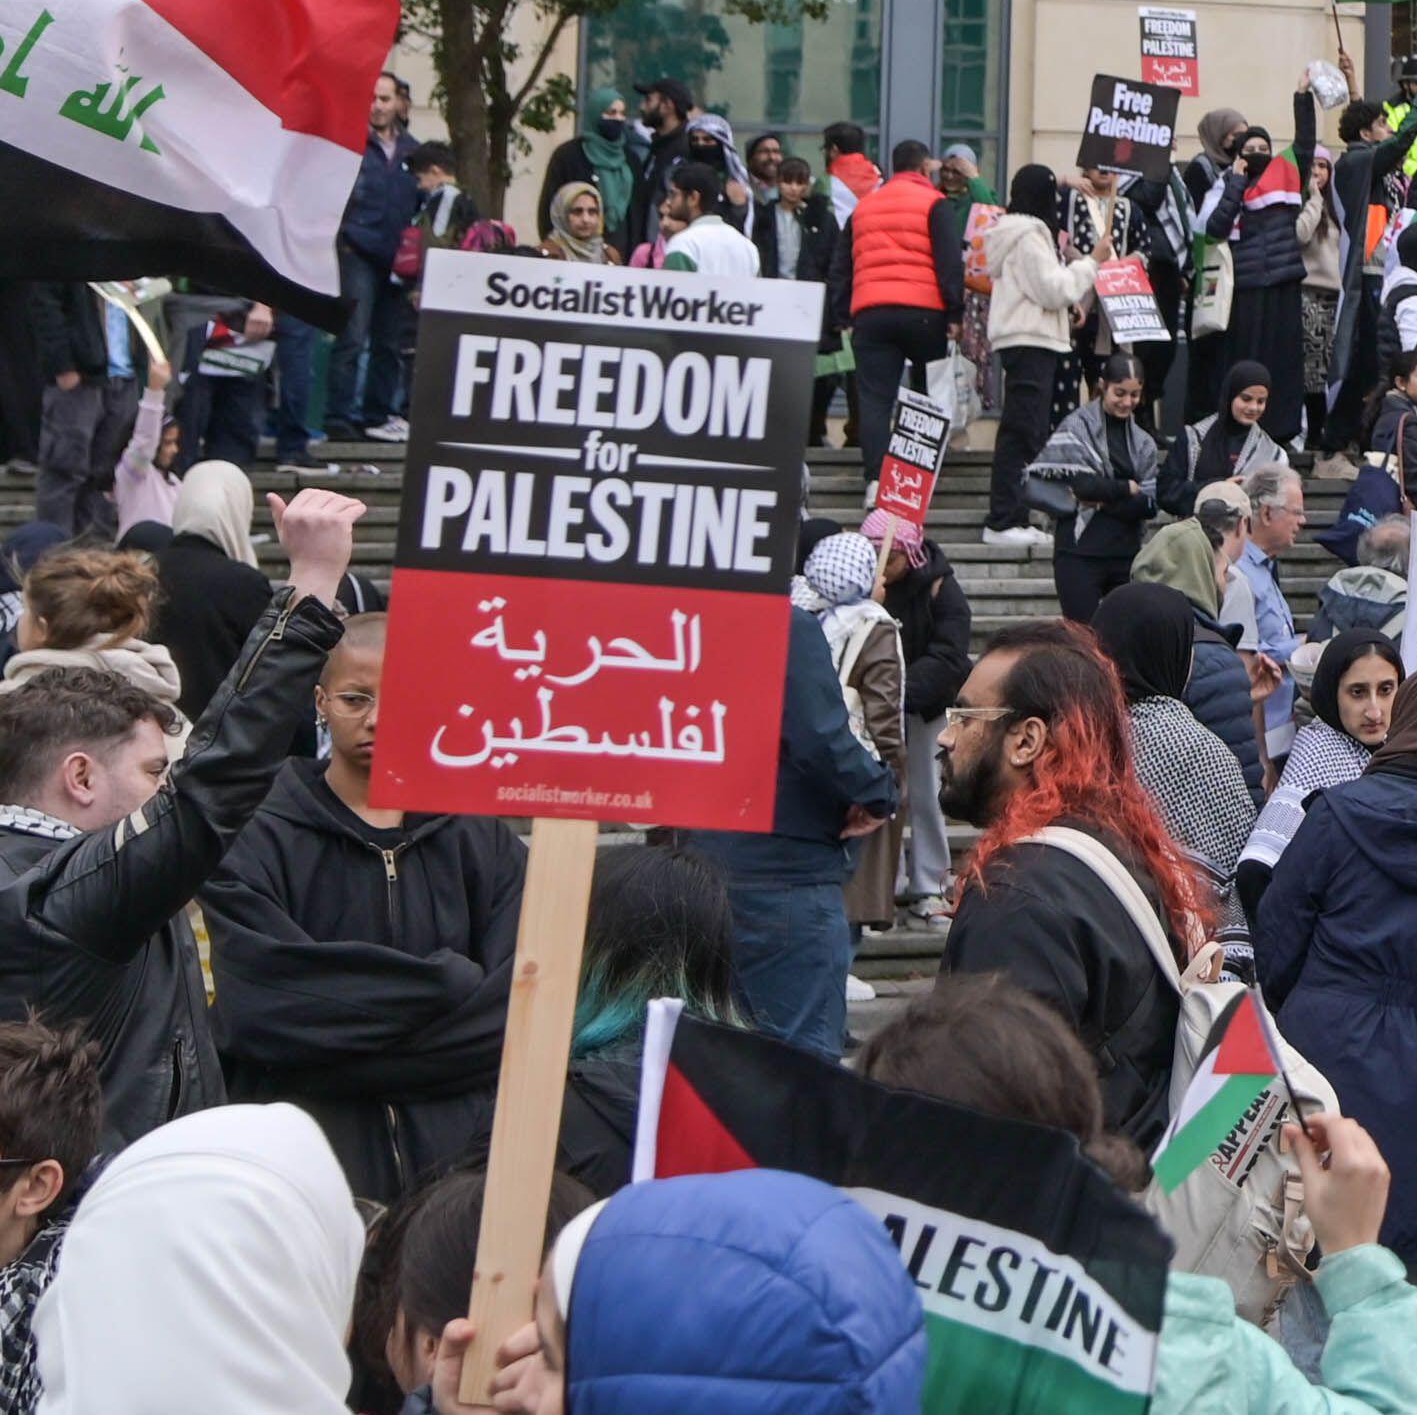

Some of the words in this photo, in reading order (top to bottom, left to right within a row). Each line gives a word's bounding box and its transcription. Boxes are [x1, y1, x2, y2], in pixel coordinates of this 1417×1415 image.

[1142, 38, 1195, 58] PALESTINE
[1144, 18, 1192, 37] FREEDOM
[1113, 82, 1152, 115] Free
[1088, 106, 1172, 147] Palestine
[450, 334, 773, 441] FREEDOM
[899, 404, 945, 442] FREEDOM
[583, 431, 638, 474] for
[888, 432, 938, 471] PALESTINE
[420, 467, 778, 574] PALESTINE
[469, 596, 702, 683] الحرية
[429, 688, 728, 769] لفلسطين
[496, 784, 654, 811] socialistworker.co.uk
[1217, 1090, 1271, 1162] APPEAL
